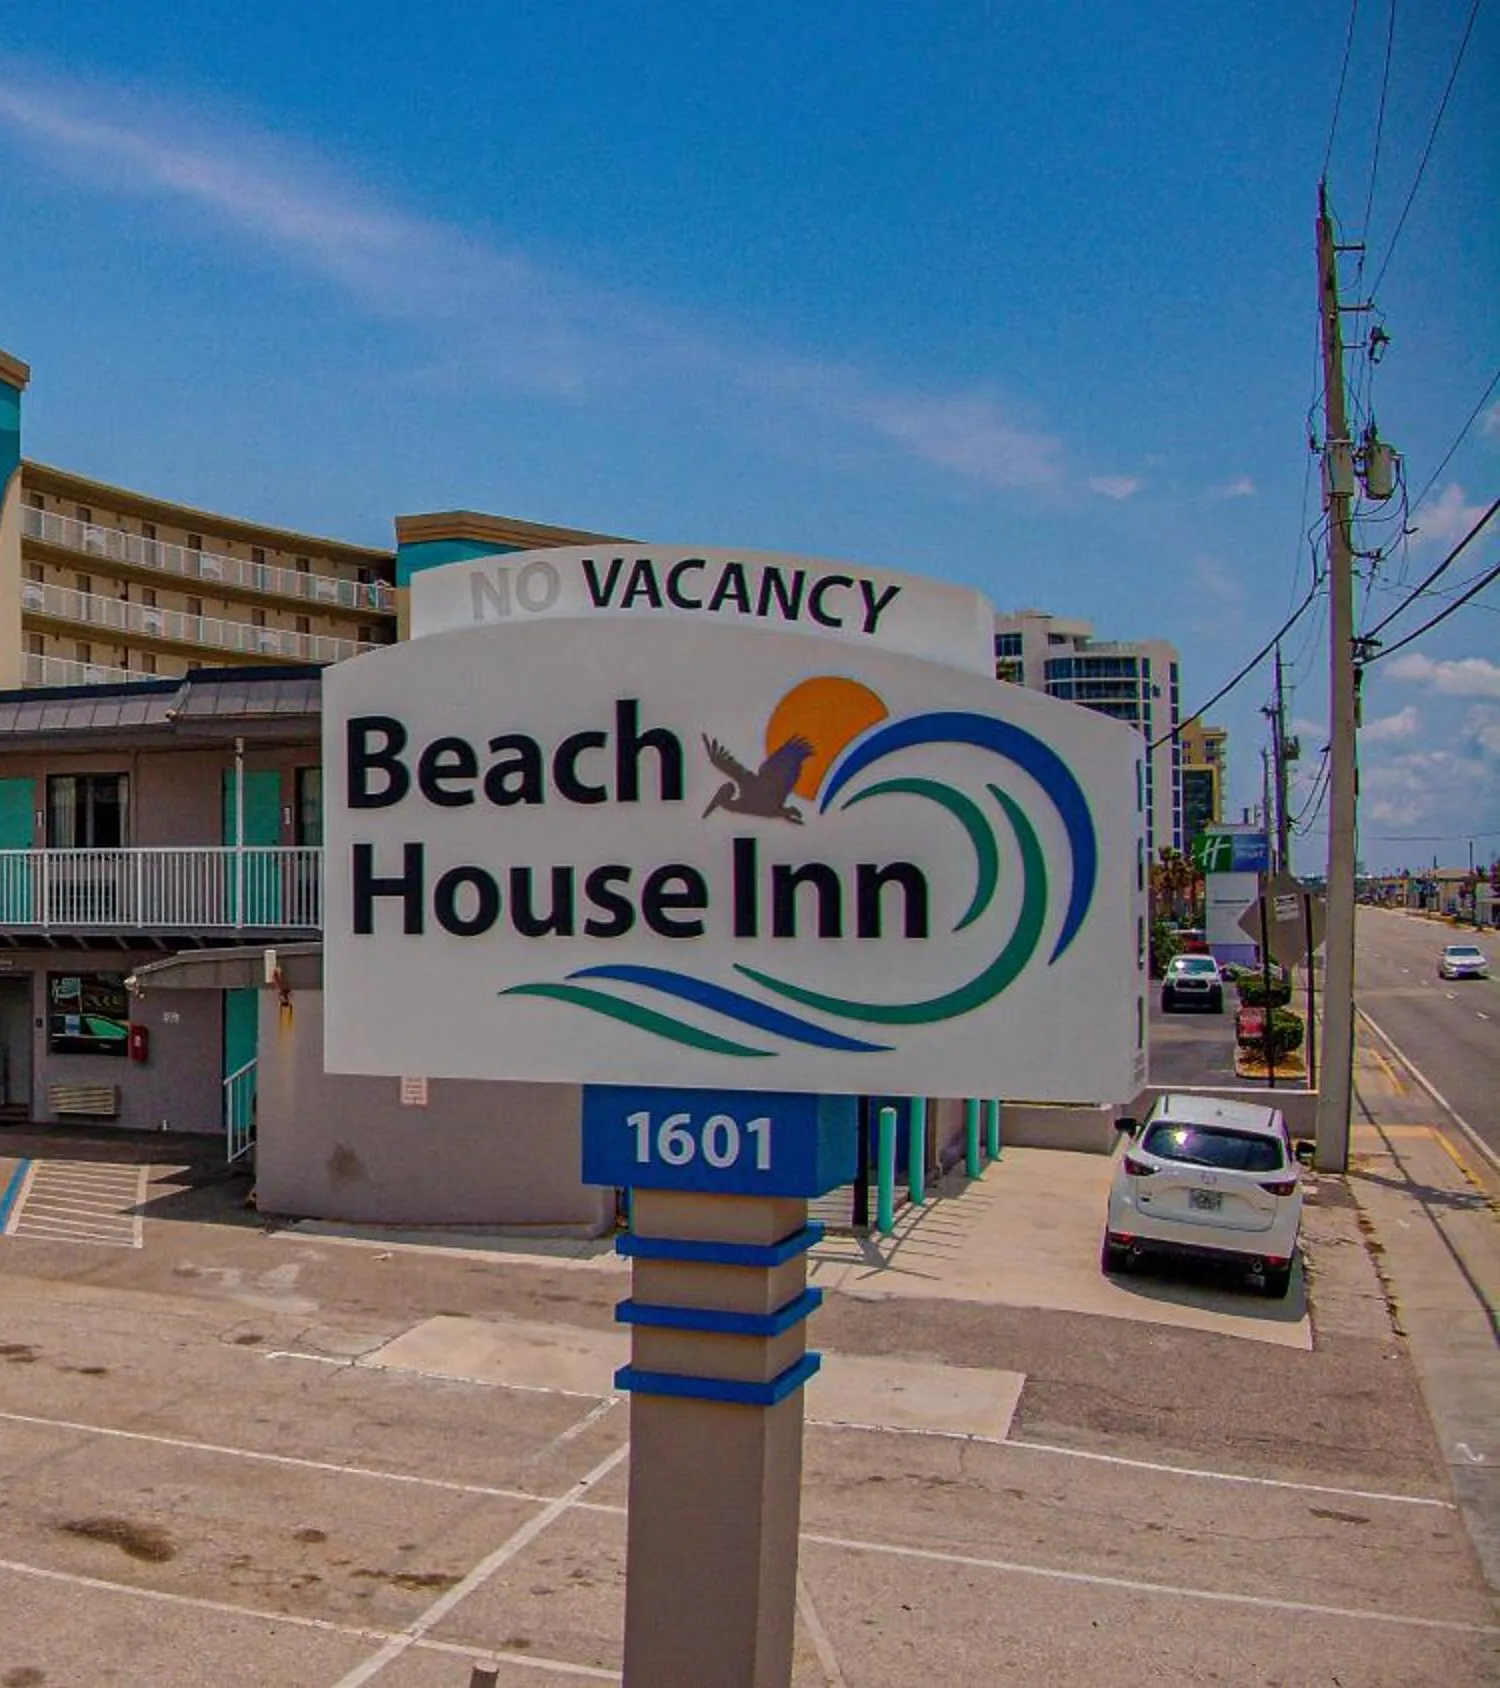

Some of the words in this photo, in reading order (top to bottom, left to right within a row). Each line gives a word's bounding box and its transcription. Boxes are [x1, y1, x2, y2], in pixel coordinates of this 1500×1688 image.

[469, 561, 560, 621] NO
[580, 556, 902, 636] VACANCY
[346, 698, 686, 810] Beach
[351, 840, 710, 940] House
[731, 836, 931, 941] Inn
[625, 1110, 772, 1170] 1601
